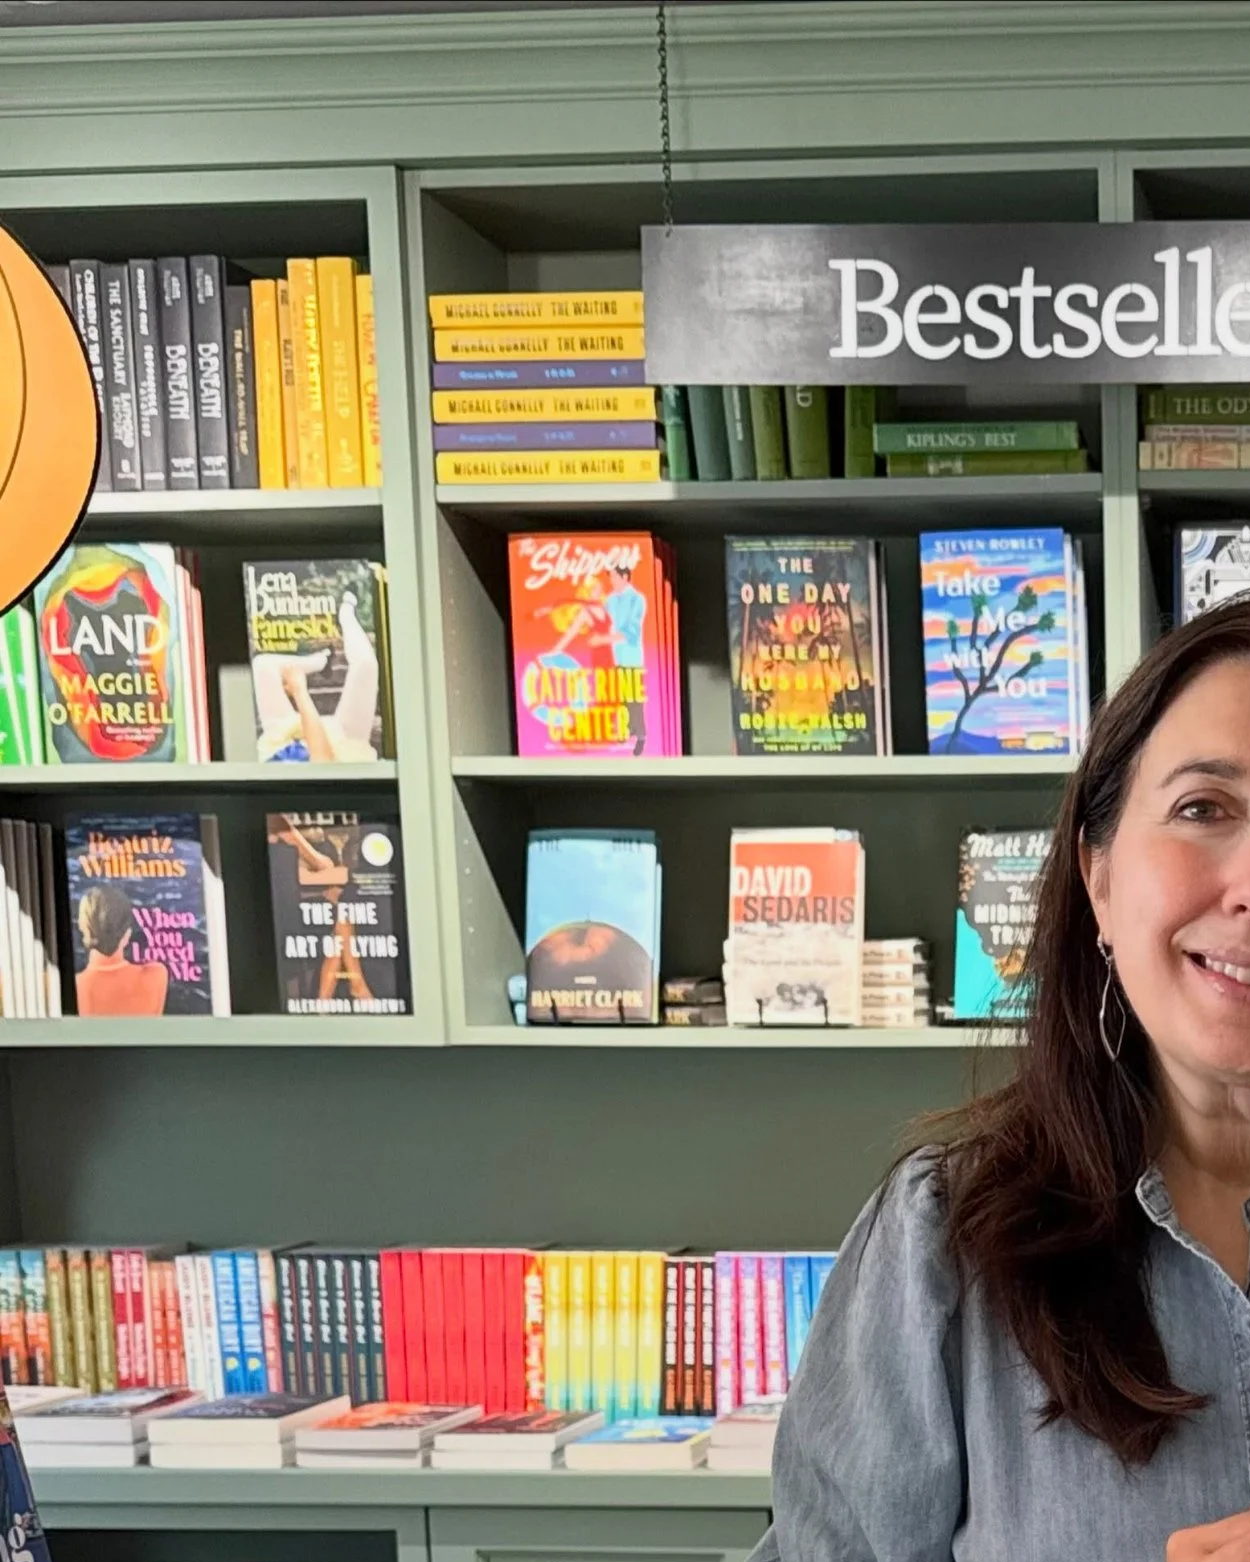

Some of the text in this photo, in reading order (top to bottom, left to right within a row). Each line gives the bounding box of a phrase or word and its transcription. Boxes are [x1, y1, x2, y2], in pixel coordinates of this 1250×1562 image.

[551, 302, 570, 317] THE
[573, 300, 618, 316] WAITING
[108, 280, 127, 386] THE SANCTUARY
[165, 344, 190, 420] BENEATH
[197, 342, 222, 419] BENEATH
[448, 400, 492, 414] MICHAEL
[553, 399, 571, 412] THE
[575, 398, 618, 411] WAITING
[1175, 398, 1213, 415] THE
[906, 432, 1018, 449] KIPLING'S BEST
[453, 462, 497, 476] MICHAEL
[560, 460, 577, 474] THE
[580, 459, 625, 474] WAITING
[934, 537, 1045, 554] STEVEN ROWLEY
[778, 557, 813, 574] THE
[249, 566, 298, 595] Lena
[934, 570, 1001, 599] Take
[250, 591, 337, 617] Dunham
[741, 582, 852, 605] ONE DAY
[251, 614, 341, 640] Famesick
[771, 613, 822, 635] YOU
[980, 606, 1028, 634] Me
[50, 613, 166, 656] LAND
[944, 647, 994, 669] with
[60, 672, 159, 696] MAGGIE
[524, 668, 647, 705] CATHERINE
[741, 671, 861, 692] HUSBAND
[49, 701, 174, 725] O'FARRELL
[547, 702, 631, 742] CENTER
[87, 829, 175, 856] Beatriz
[967, 833, 1022, 858] Matt
[79, 855, 187, 880] Williams
[732, 866, 812, 897] DAVID
[131, 907, 196, 929] When
[299, 902, 379, 926] THE FINE
[743, 896, 855, 924] SEDARIS
[144, 927, 185, 949] You
[285, 935, 399, 959] ART OF LYING
[132, 943, 196, 964] Loved
[171, 961, 203, 982] Me
[531, 989, 594, 1008] HARRIET
[595, 989, 644, 1008] CLARK
